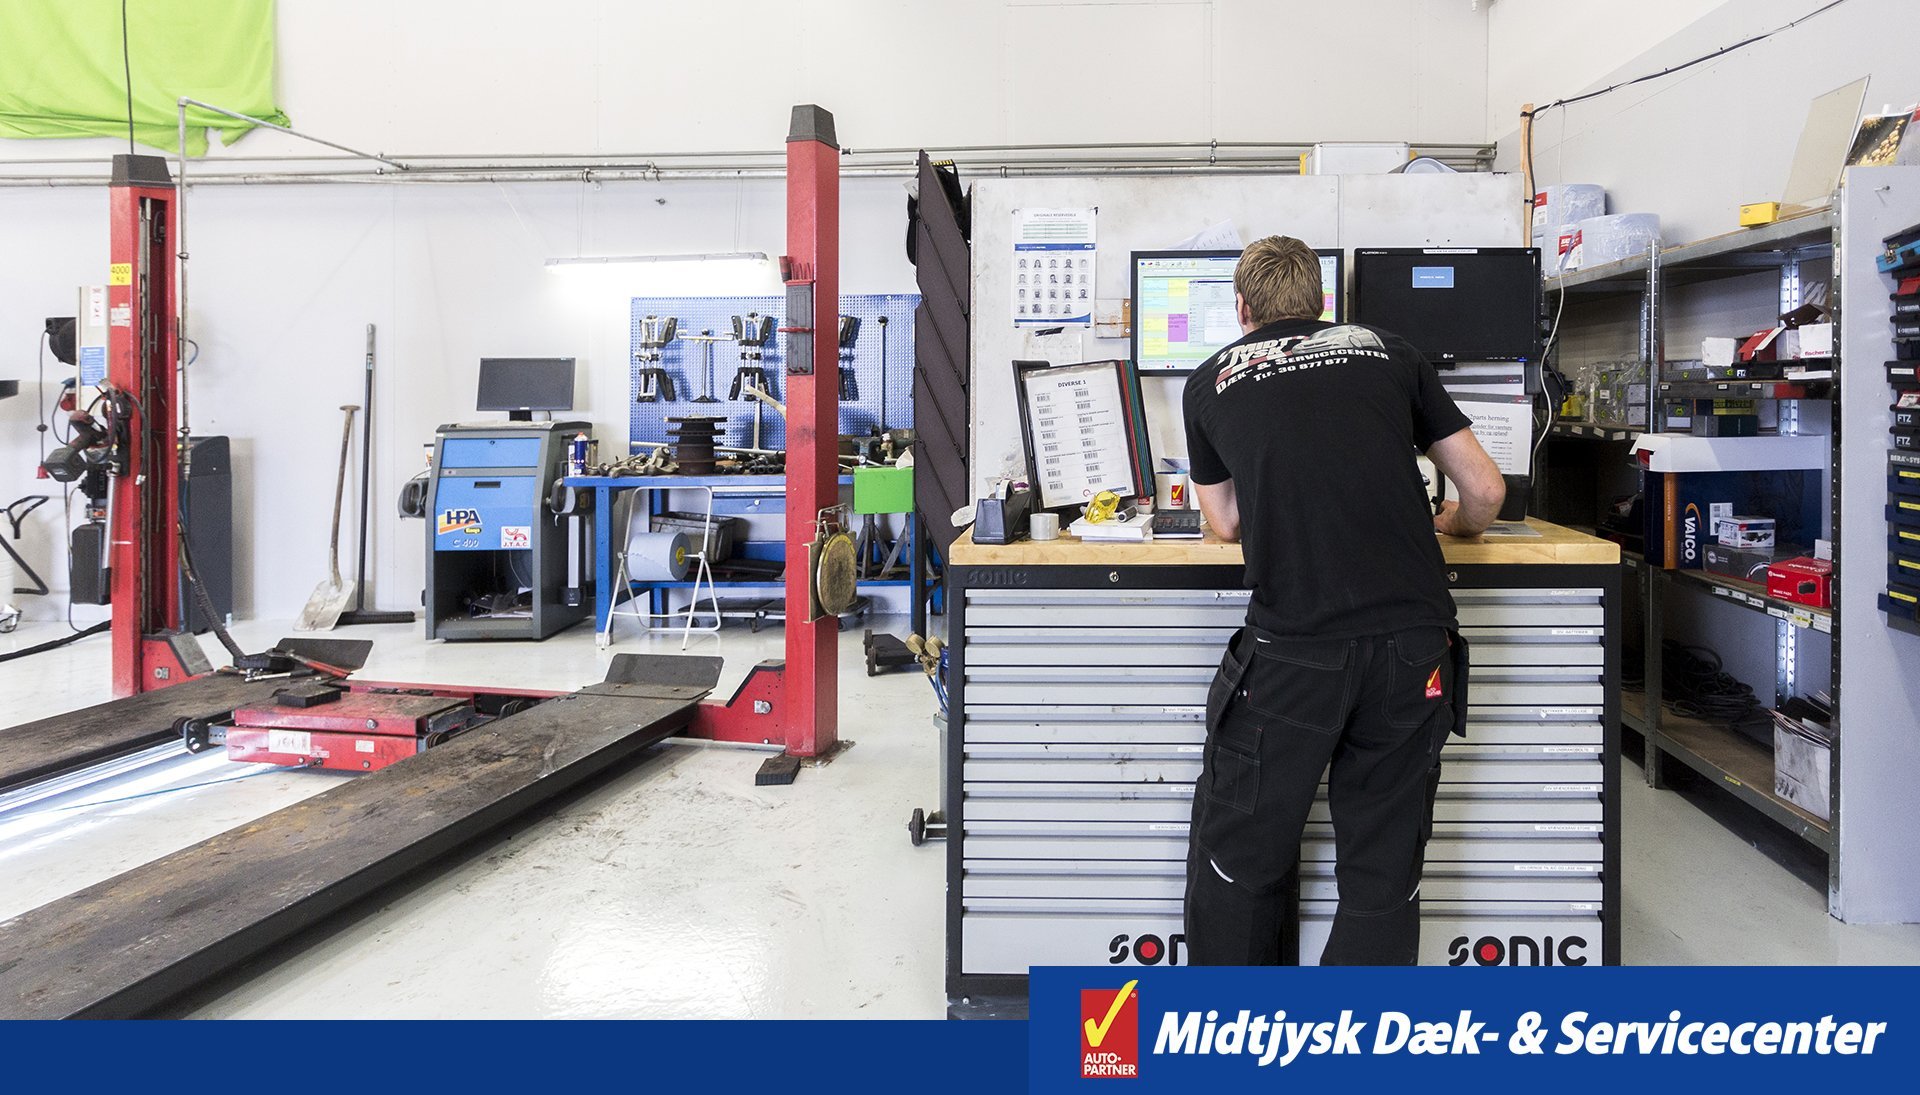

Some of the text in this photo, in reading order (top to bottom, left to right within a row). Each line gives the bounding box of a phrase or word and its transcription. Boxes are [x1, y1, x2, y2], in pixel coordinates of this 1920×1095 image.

[111, 265, 130, 274] 4000
[1257, 362, 1271, 371] &
[1278, 365, 1296, 374] 30
[1058, 380, 1081, 388] DIVERSE
[1487, 413, 1510, 423] herning
[1897, 413, 1912, 423] FTZ
[1896, 436, 1911, 446] FTZ
[446, 510, 480, 525] HPA
[1684, 516, 1696, 560] VAICO
